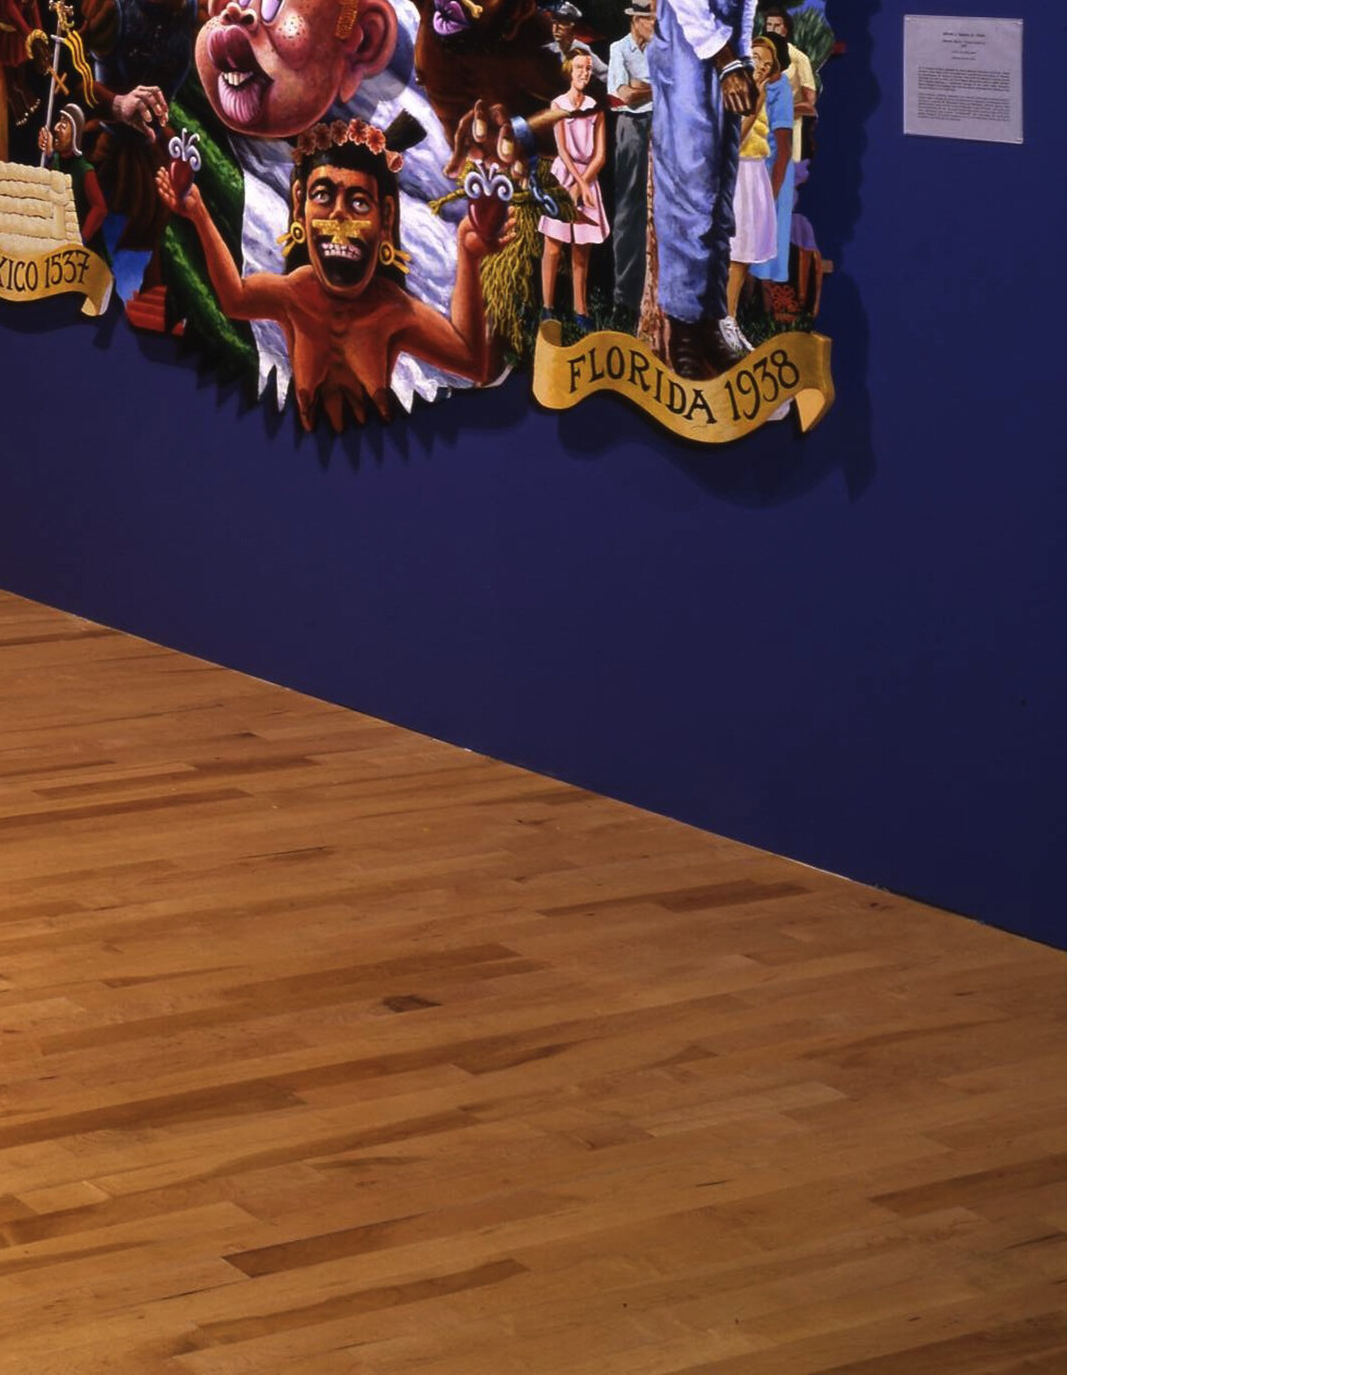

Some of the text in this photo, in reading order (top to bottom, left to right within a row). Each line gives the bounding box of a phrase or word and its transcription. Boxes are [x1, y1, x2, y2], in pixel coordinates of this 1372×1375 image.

[44, 250, 90, 289] 1537
[567, 346, 800, 424] FLORIDA 1938
